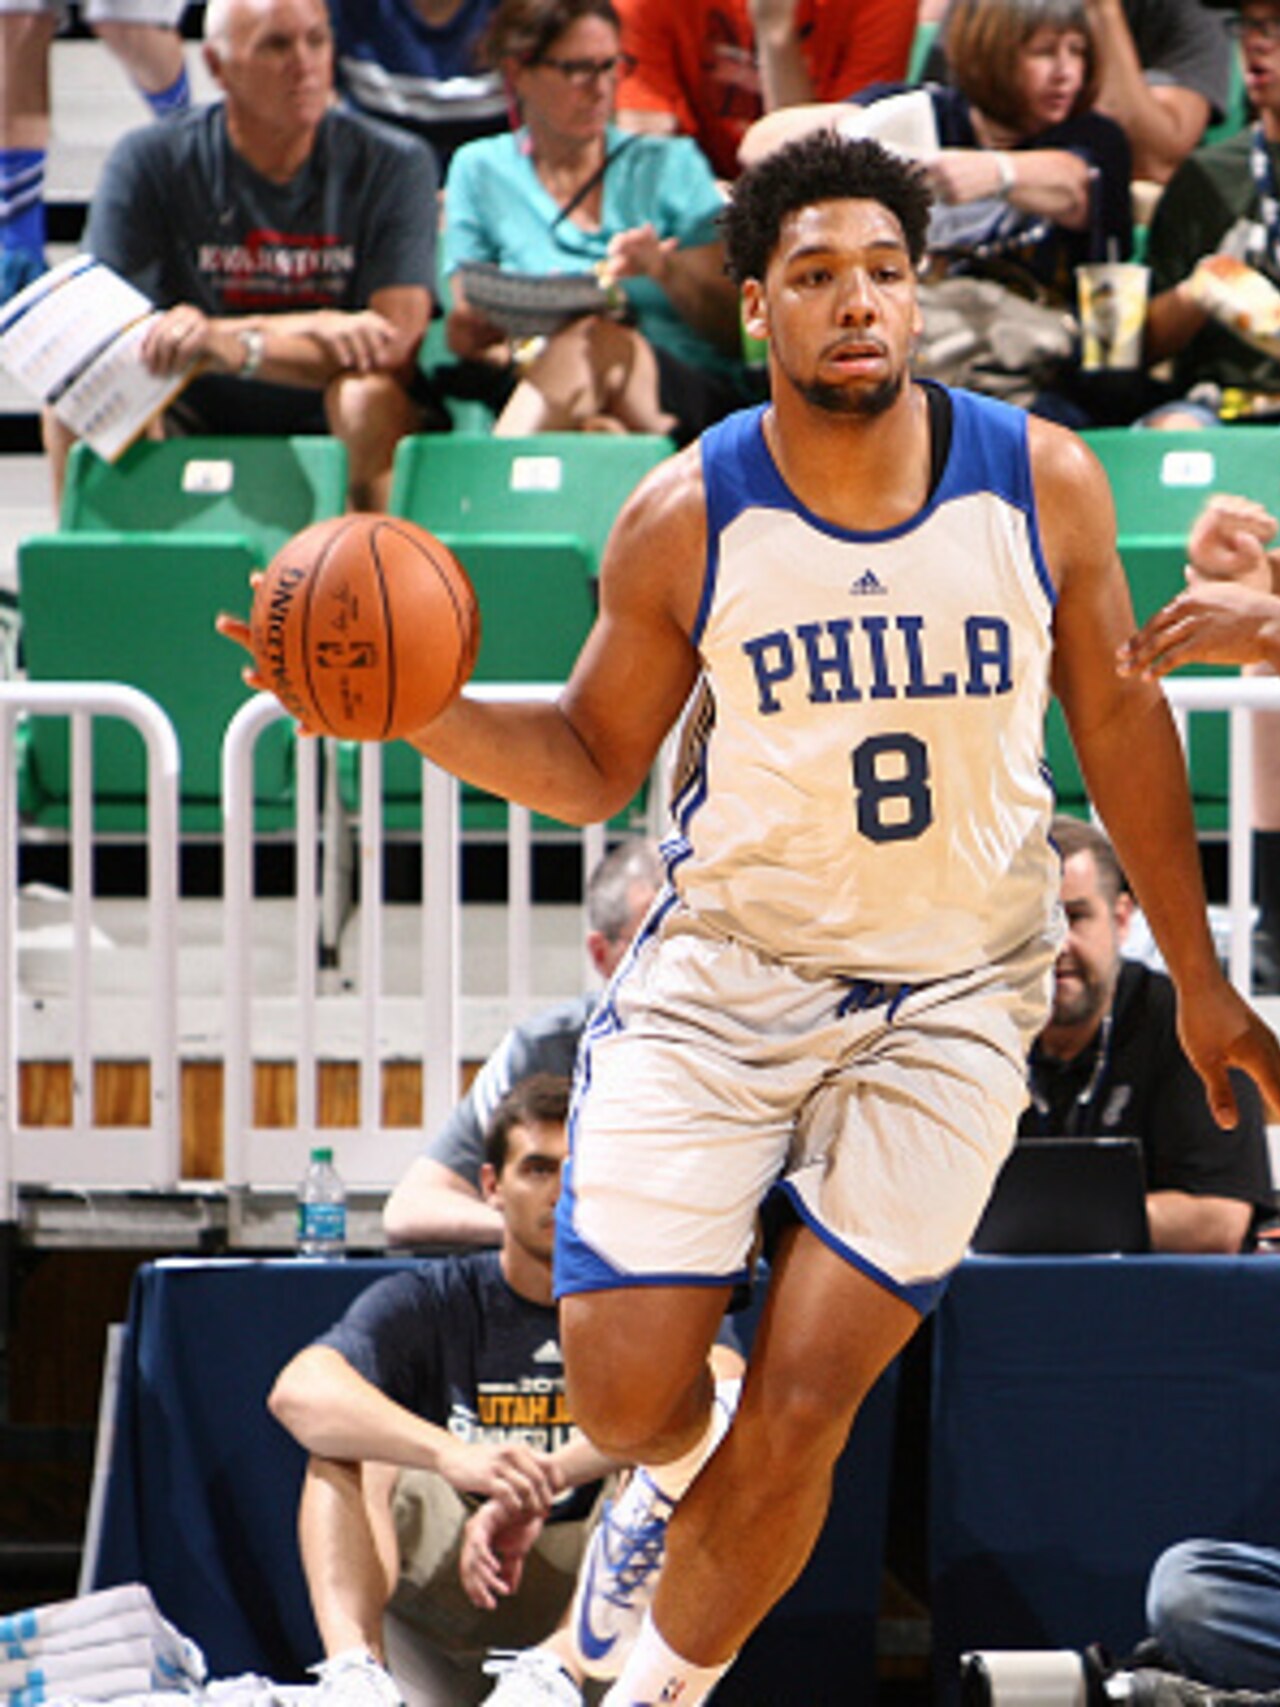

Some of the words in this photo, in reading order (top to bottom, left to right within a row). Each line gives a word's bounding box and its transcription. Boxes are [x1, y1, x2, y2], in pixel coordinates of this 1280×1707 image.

[742, 615, 1013, 715] PHILA
[851, 732, 933, 844] 8
[478, 1395, 549, 1425] UTAH
